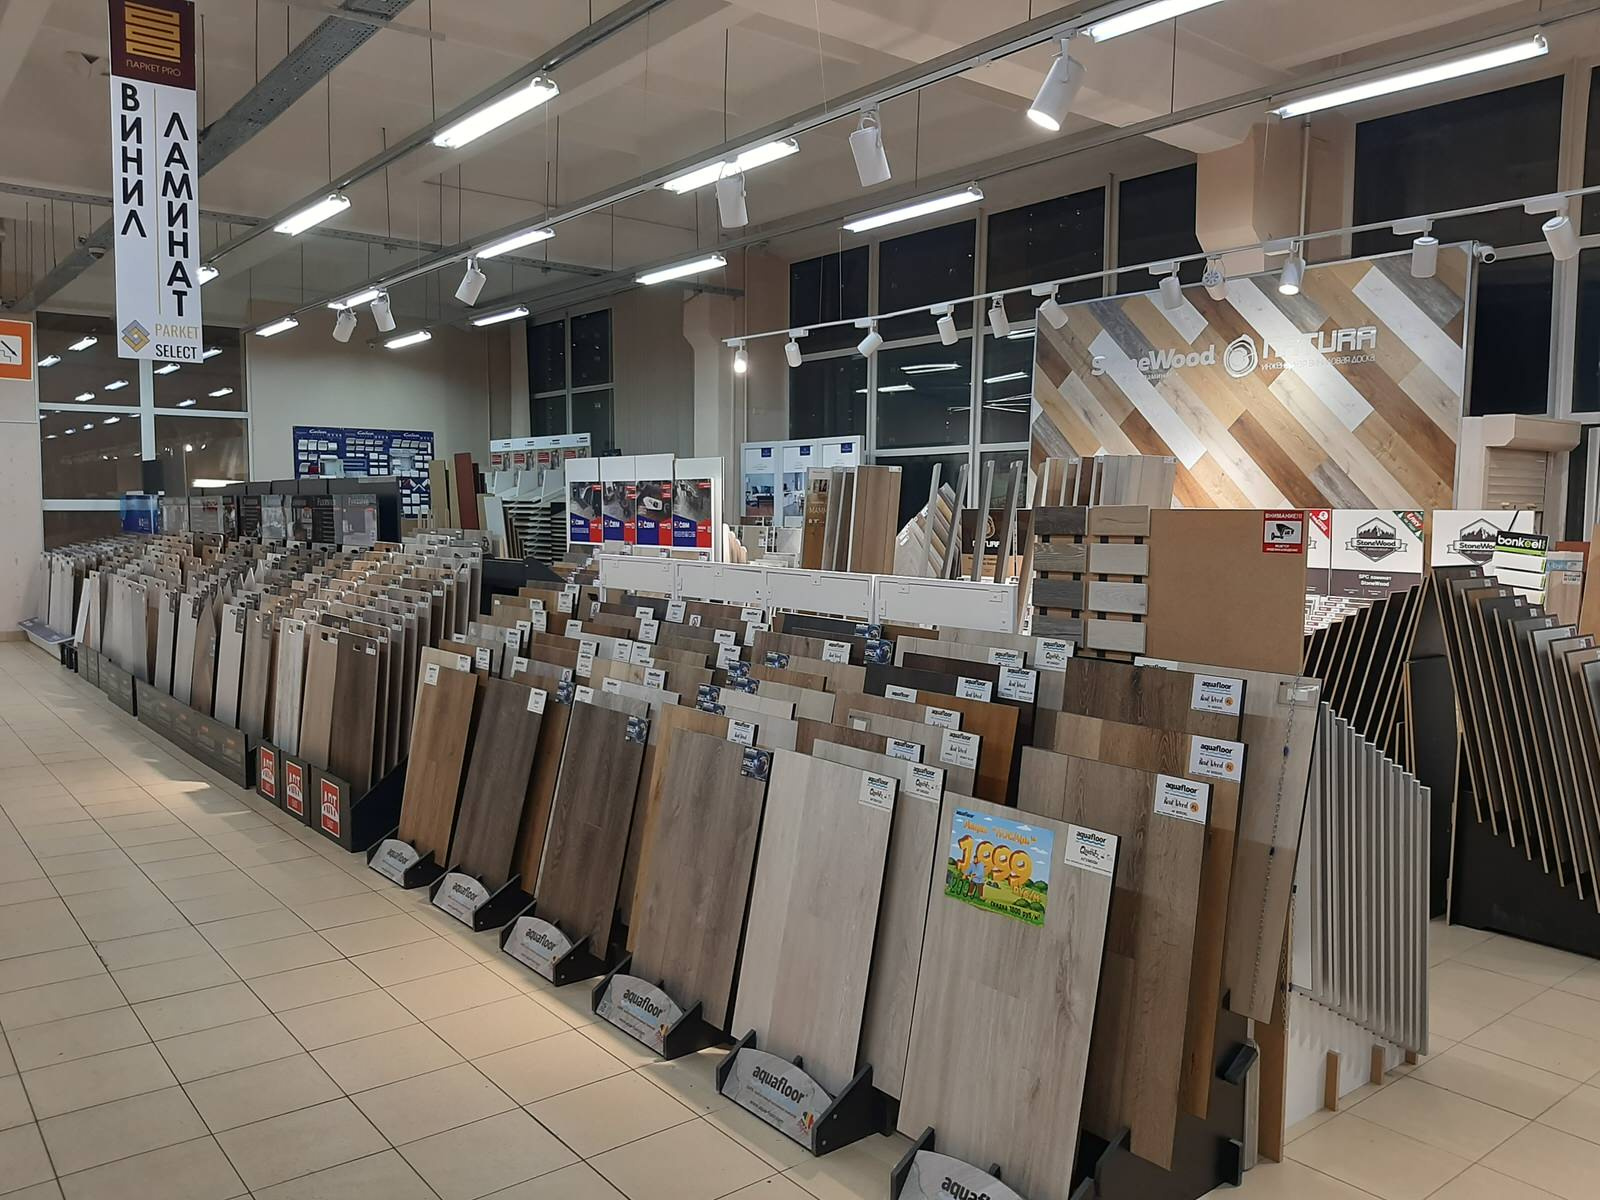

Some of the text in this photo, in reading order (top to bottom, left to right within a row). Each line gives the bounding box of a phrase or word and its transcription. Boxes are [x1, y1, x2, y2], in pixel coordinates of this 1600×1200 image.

[121, 83, 147, 239] ВИНИЛ
[162, 112, 194, 318] ЛАМИНАТ
[154, 322, 200, 340] PARKET
[155, 343, 197, 361] SELECT
[1356, 539, 1396, 547] StoneWood
[1201, 680, 1232, 690] aquafloor
[1200, 743, 1233, 754] aquafloor
[1165, 782, 1198, 794] aquafloor
[1075, 831, 1107, 844] aquafloor
[525, 928, 557, 951] aquafloor
[623, 988, 663, 1018] aquafloor
[752, 1064, 805, 1105] aquafloor
